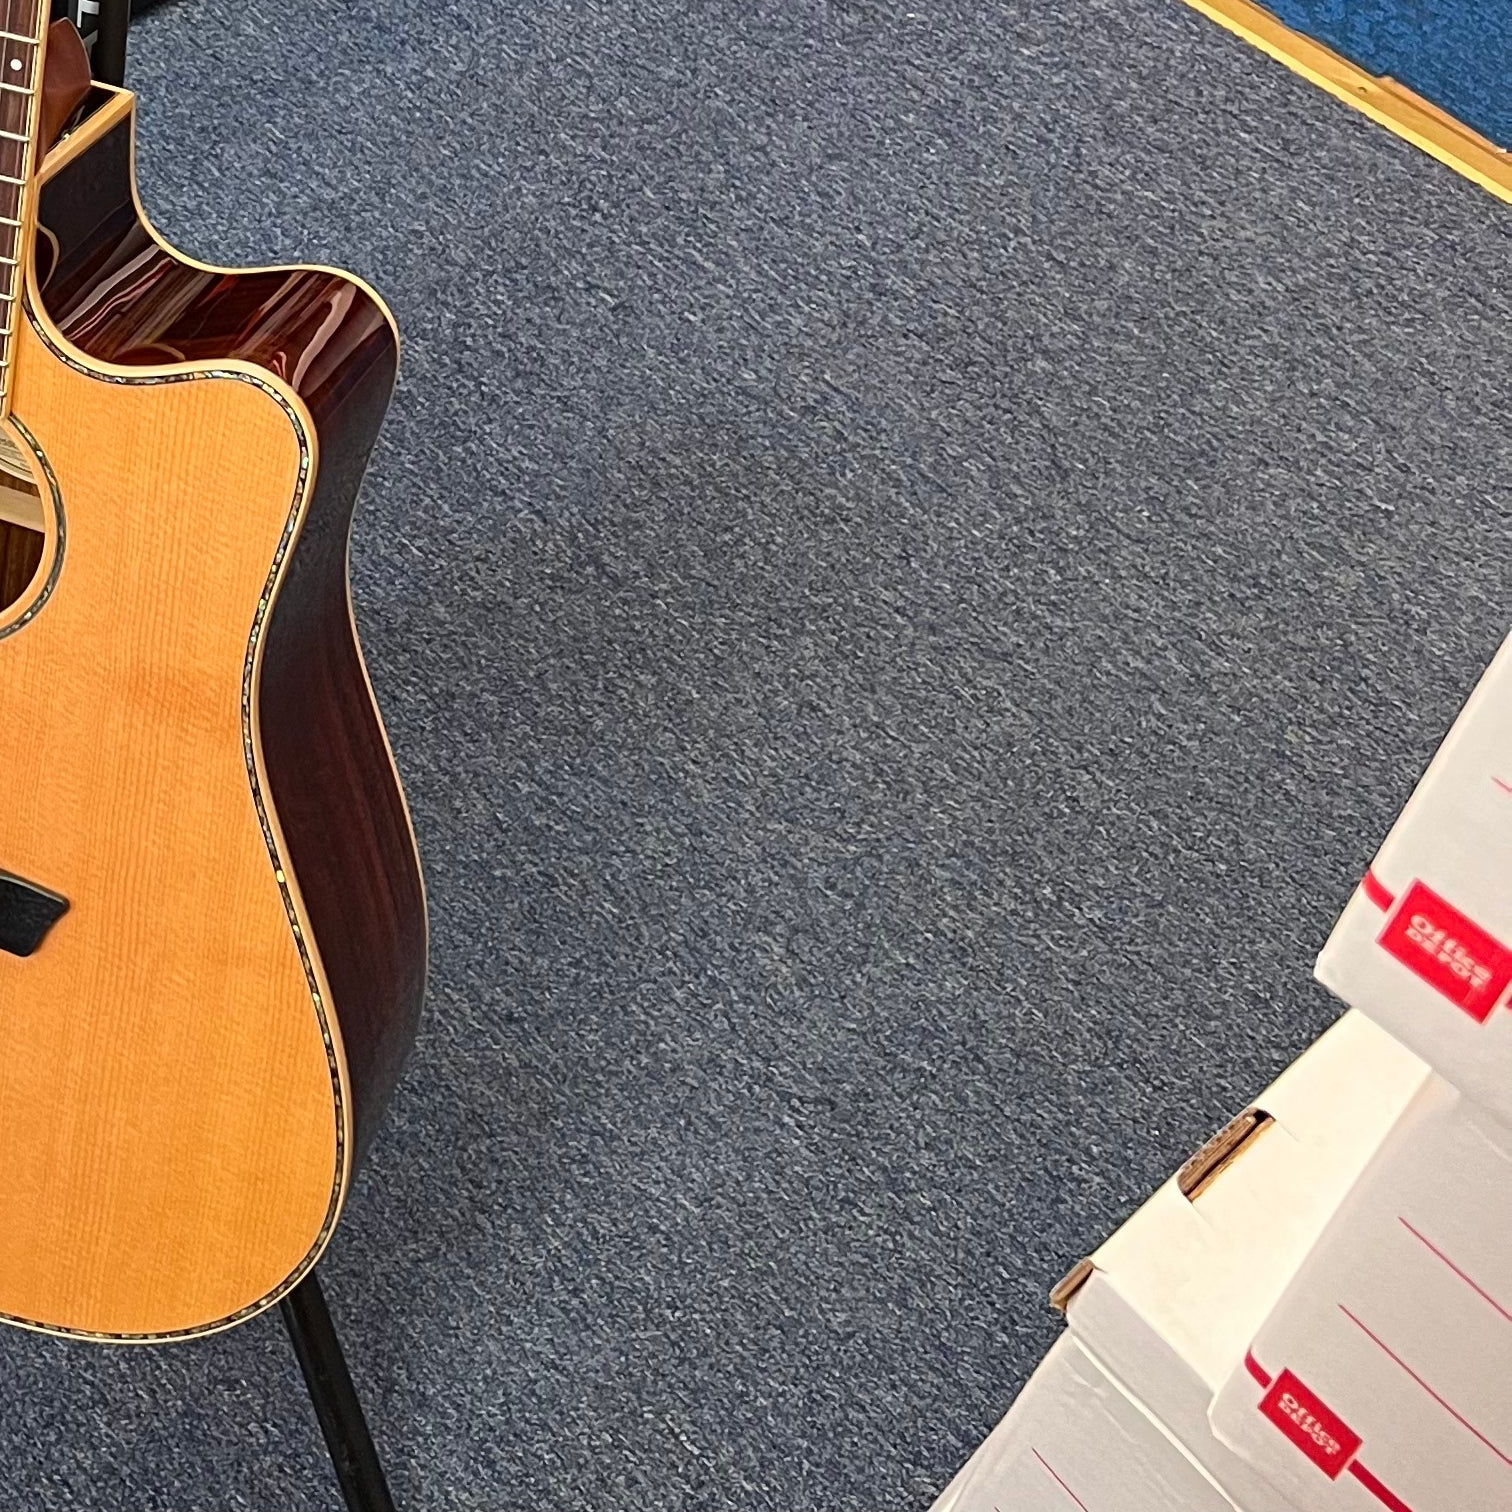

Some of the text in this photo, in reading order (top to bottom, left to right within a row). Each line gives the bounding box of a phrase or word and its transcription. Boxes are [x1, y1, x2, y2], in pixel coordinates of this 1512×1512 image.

[1404, 925, 1486, 989] DEPOT
[1410, 914, 1492, 982] Office
[1278, 1399, 1336, 1455] DEPOT
[1282, 1392, 1340, 1451] Office
